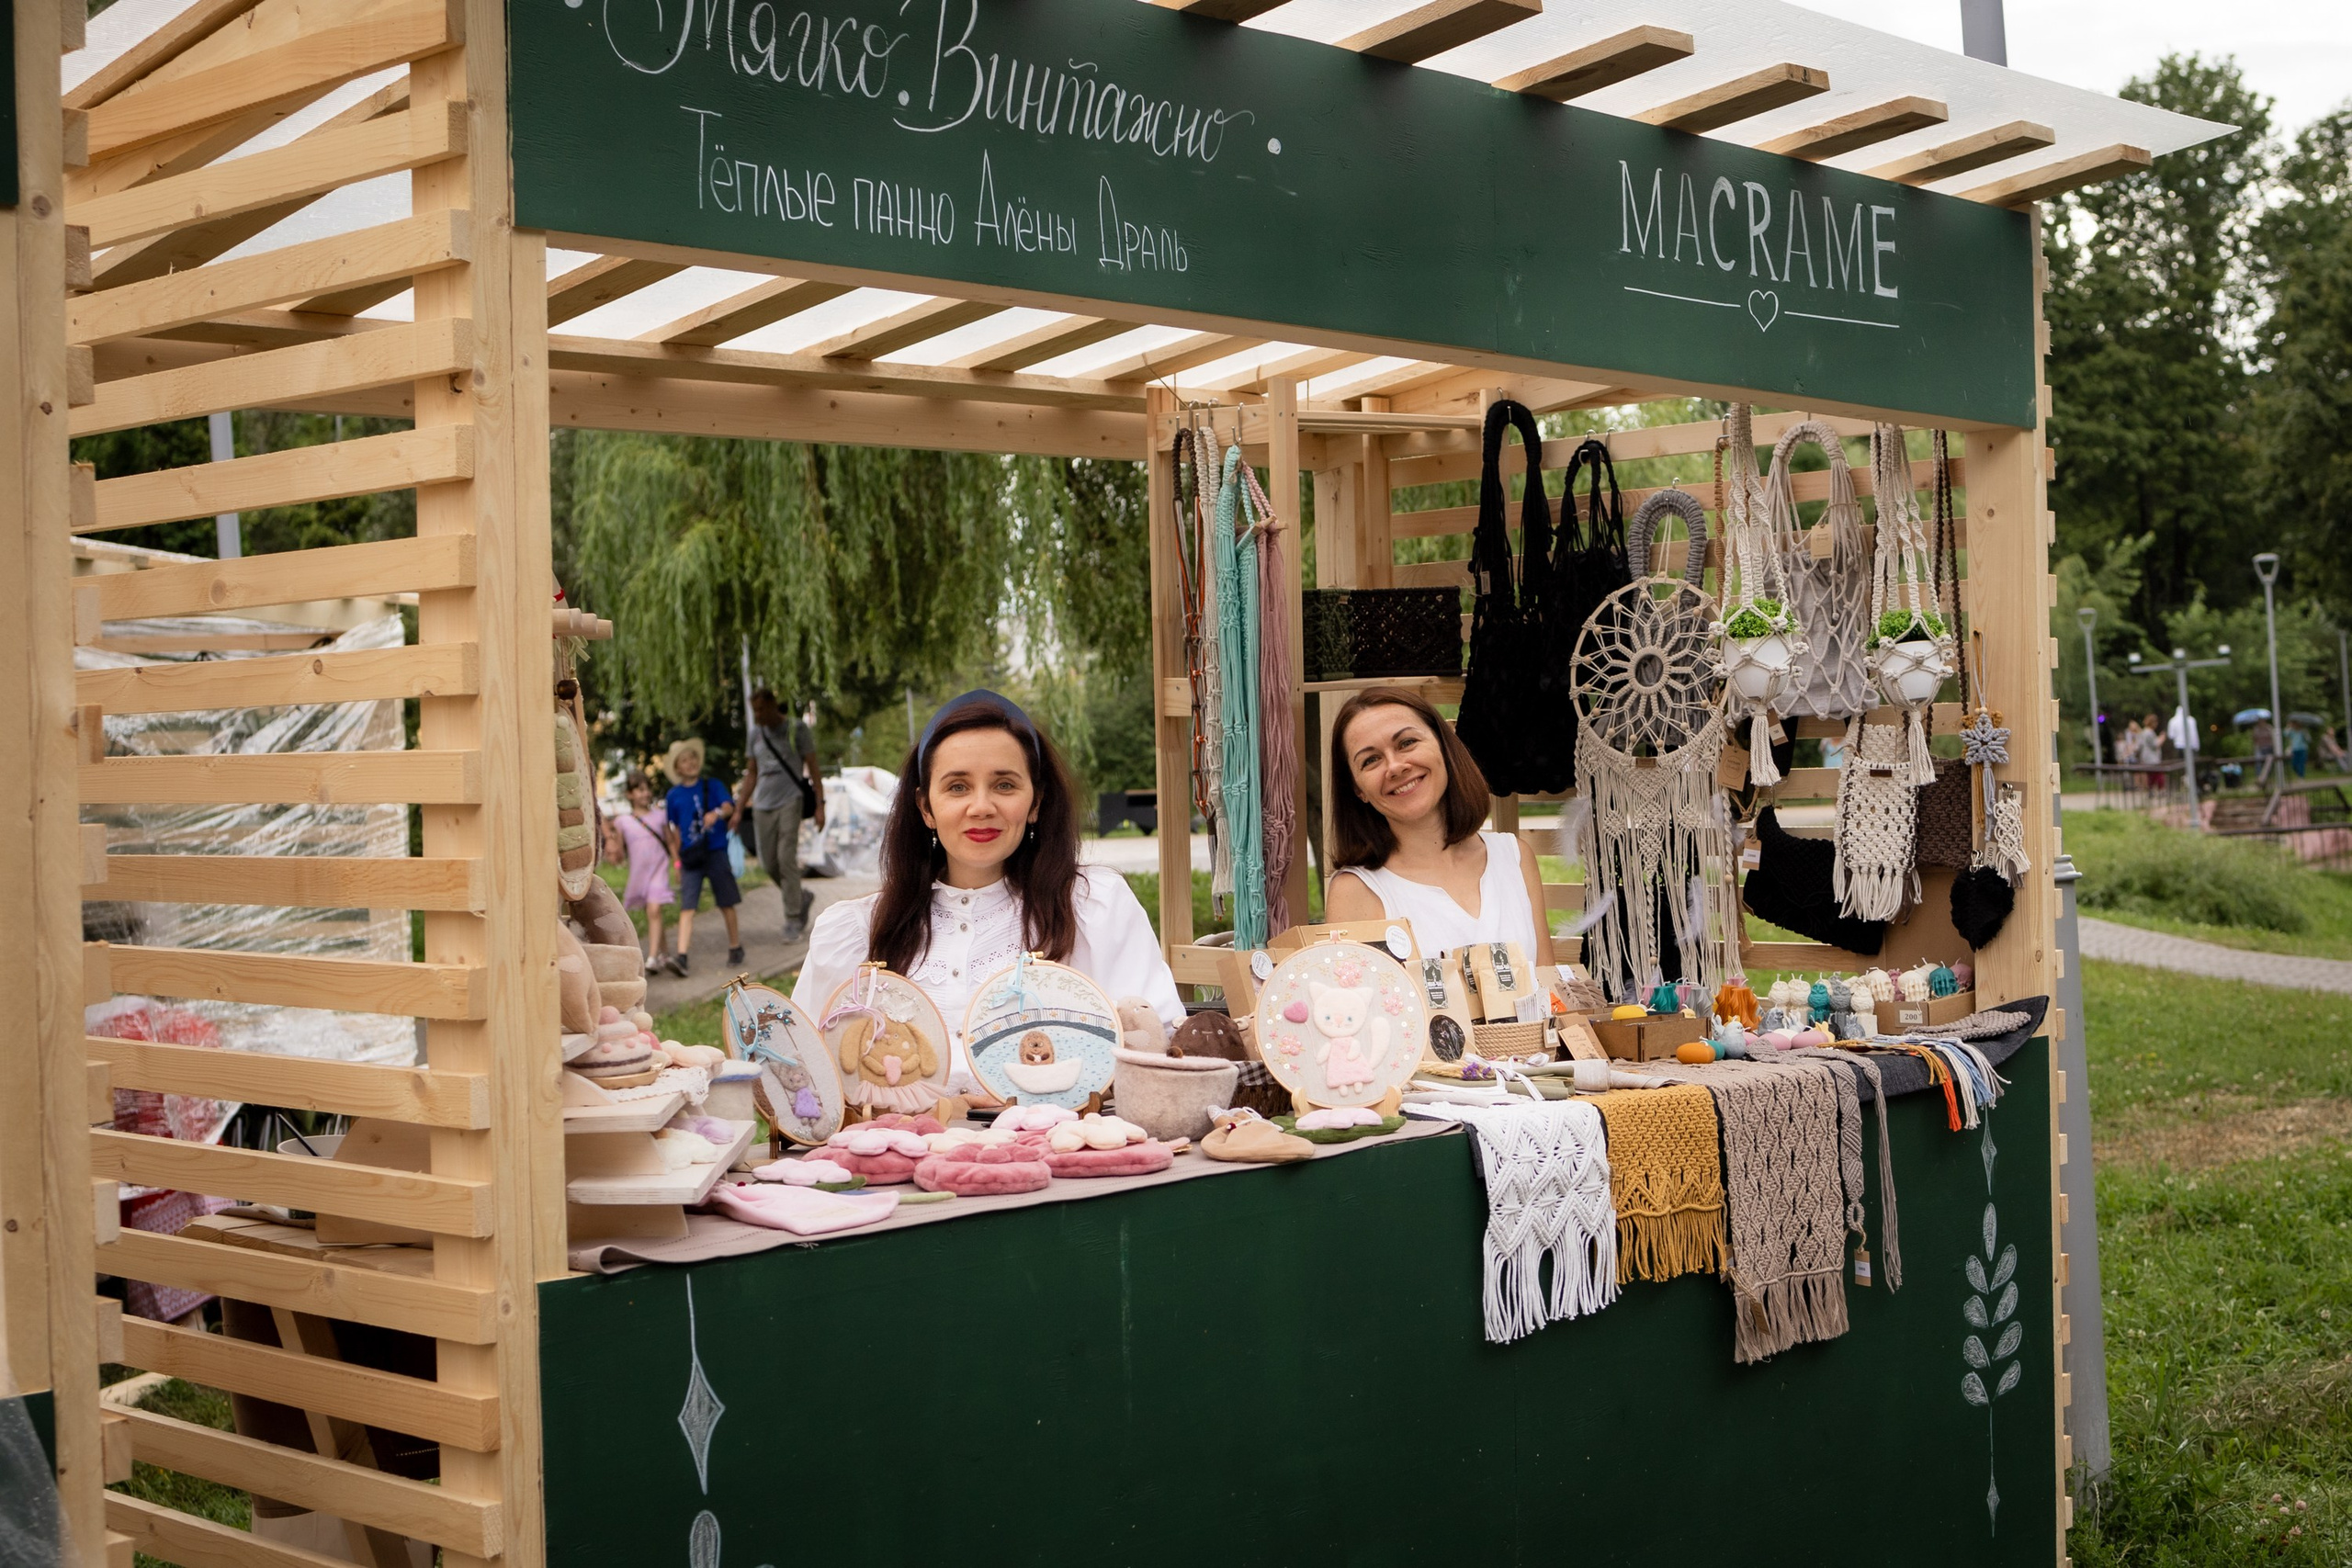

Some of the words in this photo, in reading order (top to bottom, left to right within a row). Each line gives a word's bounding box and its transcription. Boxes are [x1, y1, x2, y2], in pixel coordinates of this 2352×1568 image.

[892, 0, 1256, 164] Винтажно
[680, 105, 836, 227] Тёплые
[1618, 160, 1899, 299] MACRAME
[1986, 847, 1995, 862] 200
